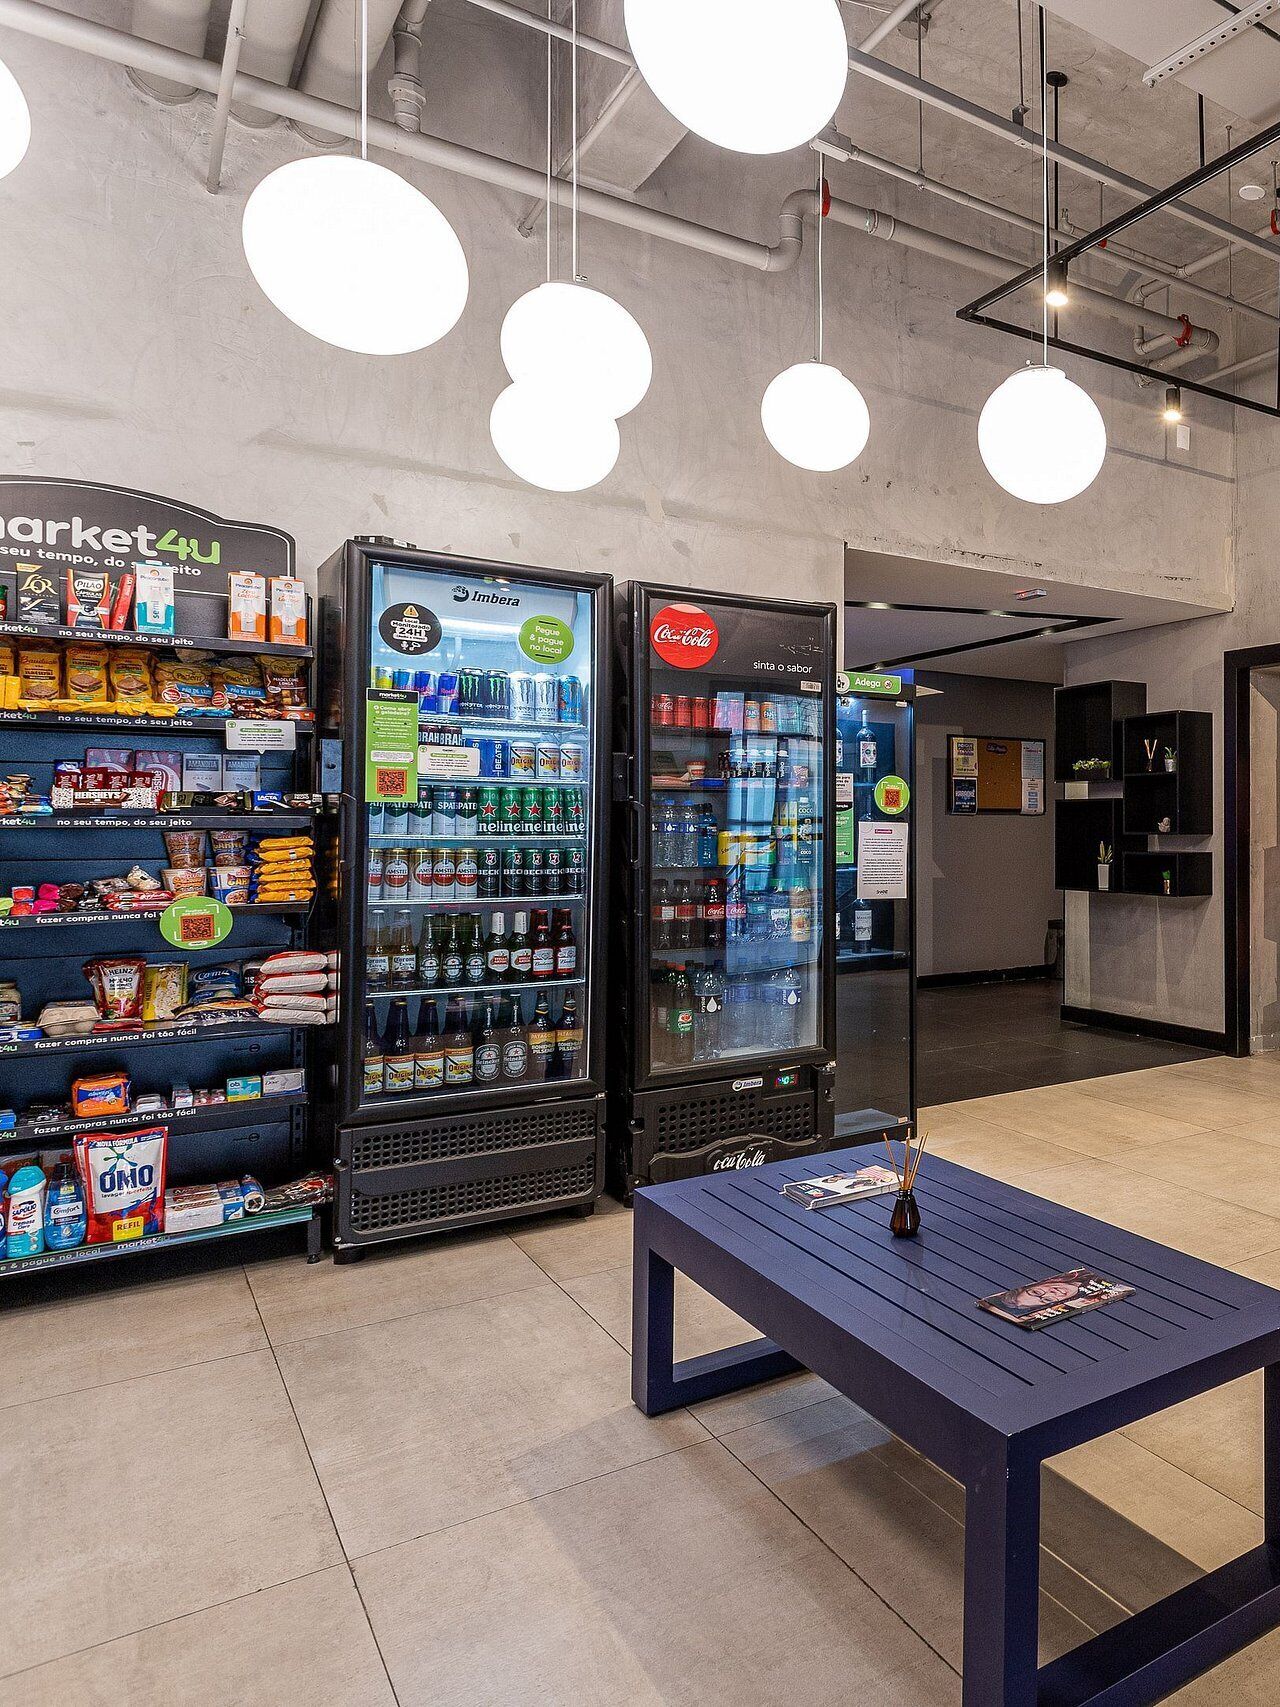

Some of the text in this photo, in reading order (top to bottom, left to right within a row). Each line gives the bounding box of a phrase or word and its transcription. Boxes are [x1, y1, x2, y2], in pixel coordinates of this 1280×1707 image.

[36, 548, 99, 567] tempo,
[104, 556, 126, 568] do
[166, 562, 202, 577] eito
[471, 590, 520, 607] Imbera
[400, 628, 422, 636] 24H
[535, 625, 560, 637] Pegue
[653, 623, 714, 648] Coca-Cola
[96, 631, 133, 642] tempo,
[136, 635, 149, 643] do
[170, 637, 194, 646] jeito
[538, 636, 564, 647] pague
[542, 644, 563, 654] local
[753, 660, 775, 671] sinta
[787, 663, 813, 674] sabor
[855, 677, 881, 688] Adega
[96, 716, 132, 726] tempo,
[135, 717, 147, 725] do
[170, 718, 193, 727] jeito
[95, 818, 131, 827] tempo,
[134, 818, 147, 826] do
[169, 818, 192, 827] jeito
[36, 911, 157, 924] fazer compras nunca foi
[34, 1041, 61, 1049] fazer
[65, 1036, 107, 1046] compras
[111, 1034, 139, 1042] nunca
[142, 1031, 155, 1040] foi
[177, 1028, 197, 1036] fácil
[34, 1126, 60, 1134] fazer
[64, 1121, 107, 1133] compras
[110, 1117, 138, 1125] nunca
[142, 1114, 155, 1122] foi
[177, 1108, 197, 1117] fácil
[100, 1165, 154, 1193] OMO
[53, 1206, 80, 1215] Comfort
[116, 1222, 141, 1231] REFIL
[22, 1257, 56, 1268] pague
[75, 1248, 102, 1258] local
